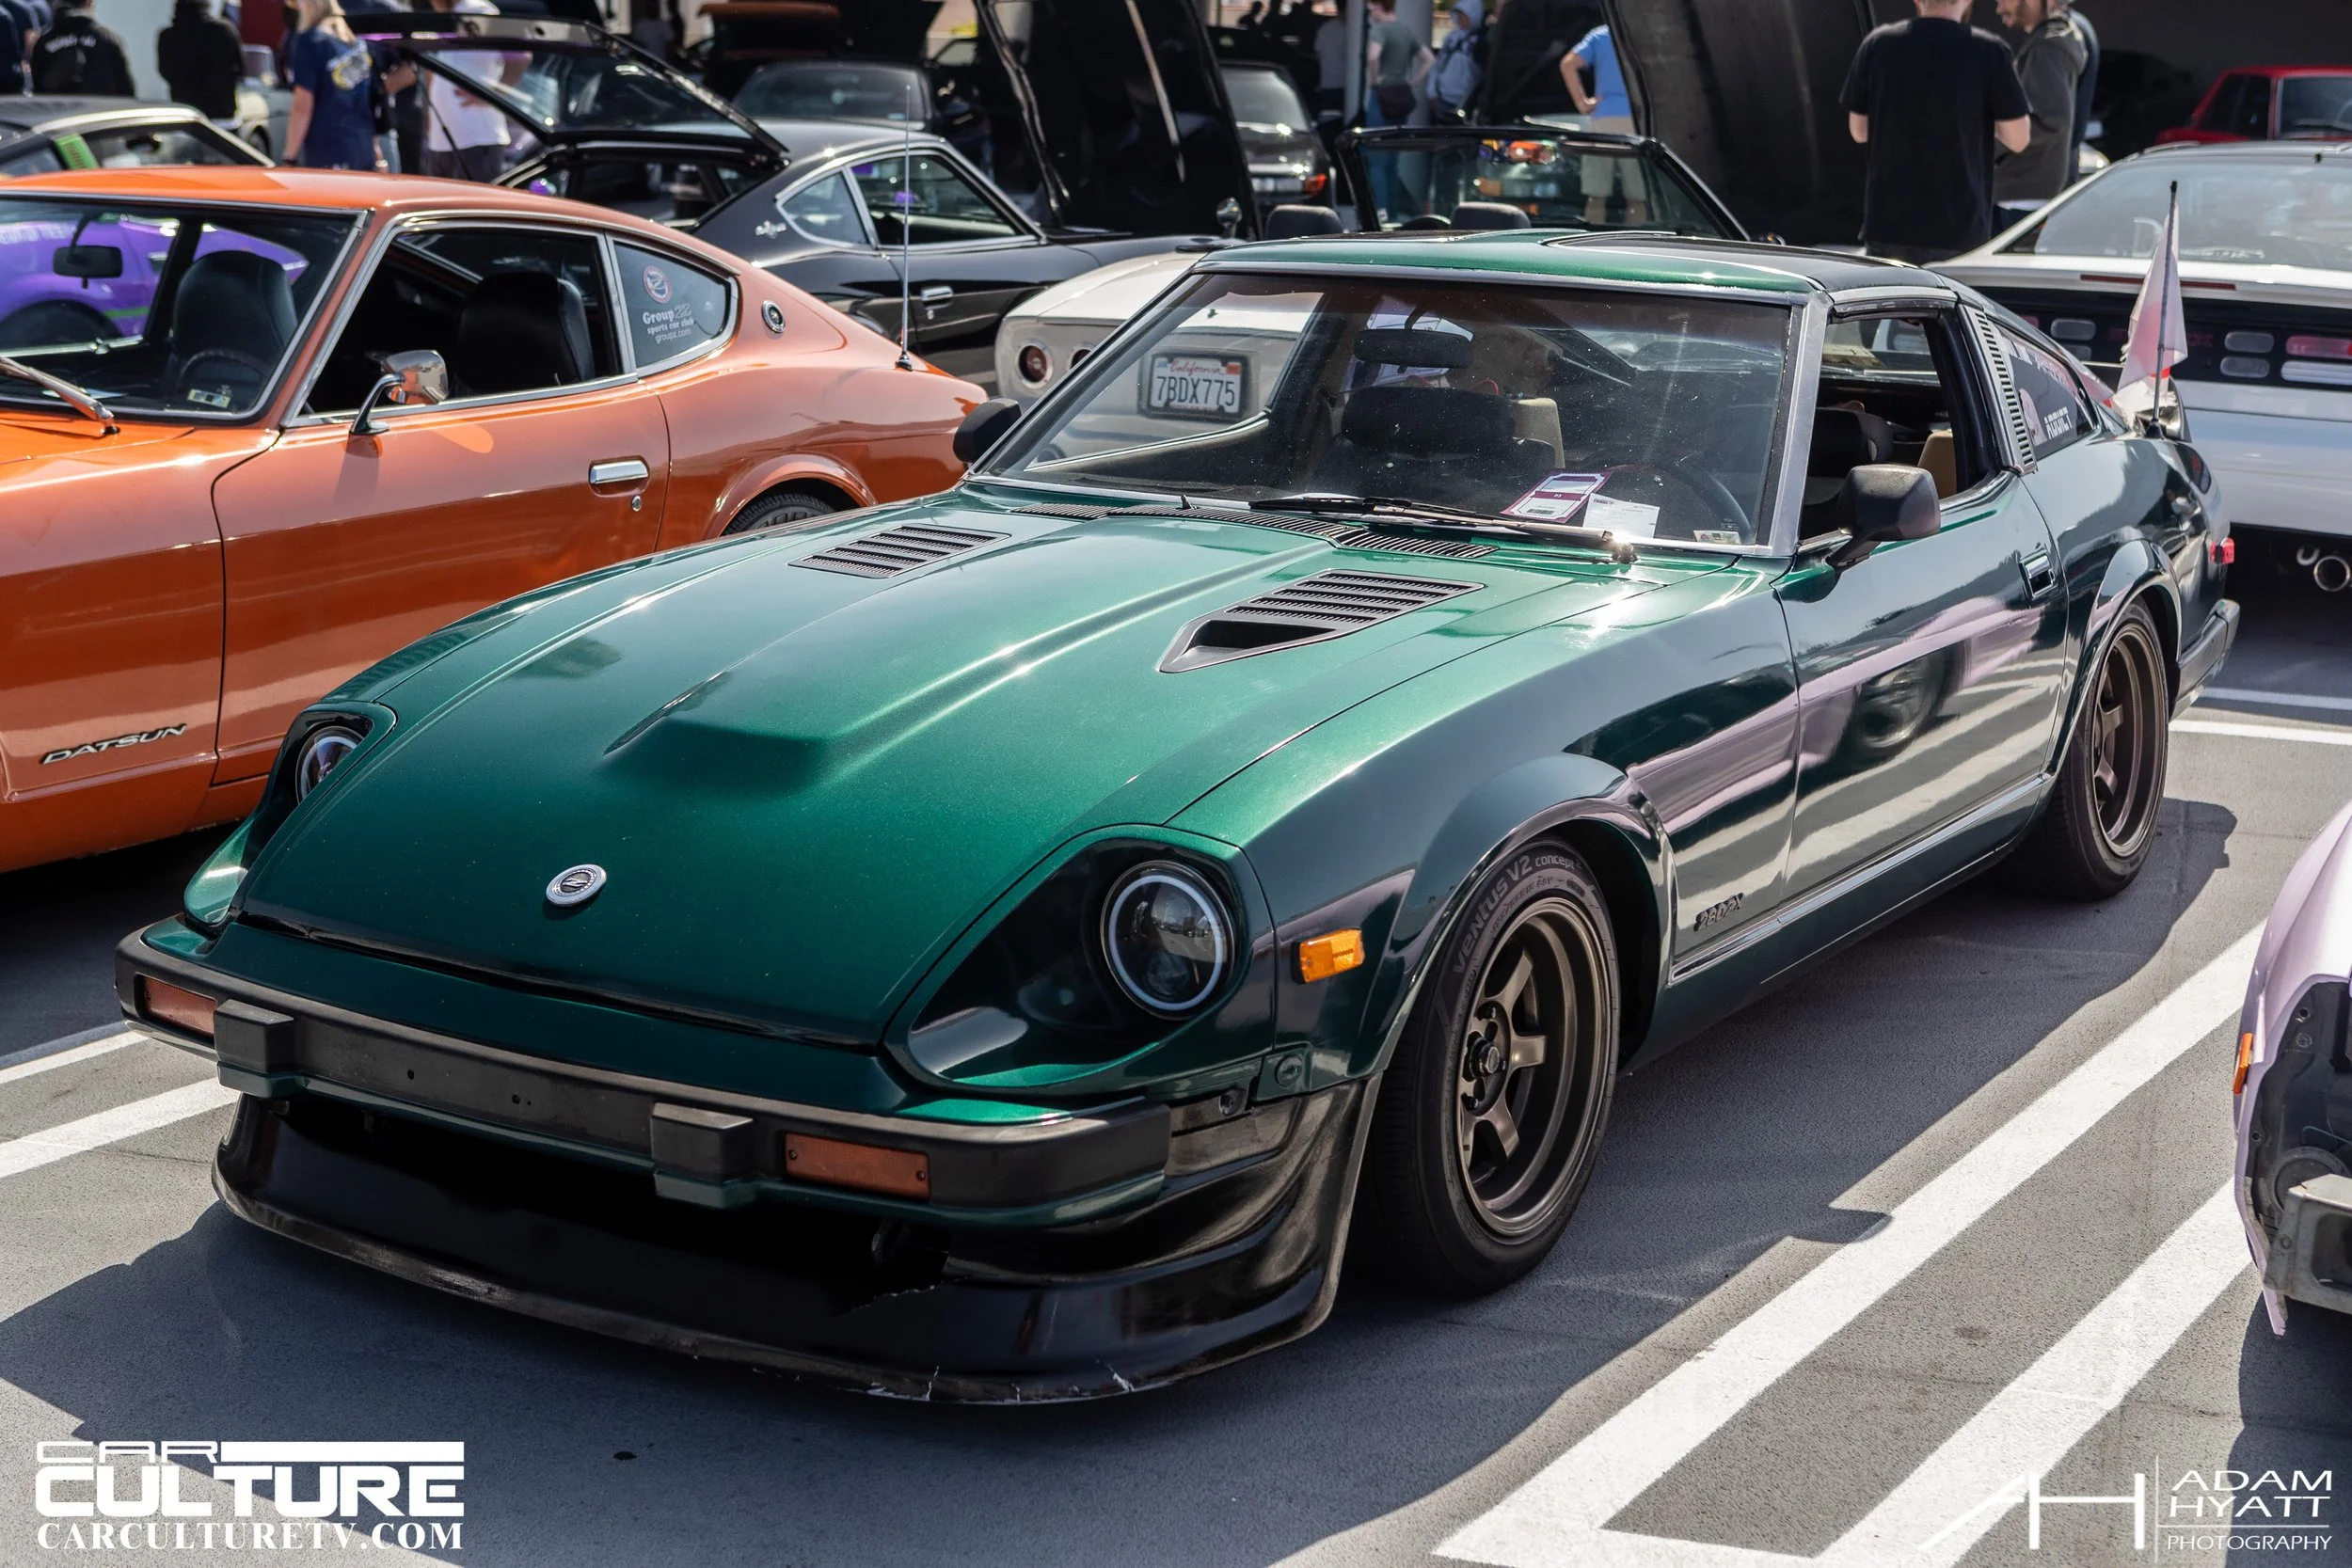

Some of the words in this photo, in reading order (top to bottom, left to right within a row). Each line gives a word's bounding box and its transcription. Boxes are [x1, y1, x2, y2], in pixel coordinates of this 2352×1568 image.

[642, 310, 675, 325] Group
[647, 325, 668, 335] sports
[681, 317, 694, 325] club
[655, 328, 691, 344] groupz.com
[1170, 359, 1221, 376] California
[1156, 375, 1236, 406] 7BDX775
[40, 722, 187, 765] DATSUN
[1506, 855, 1534, 881] V2
[1693, 892, 1744, 932] 280ZX
